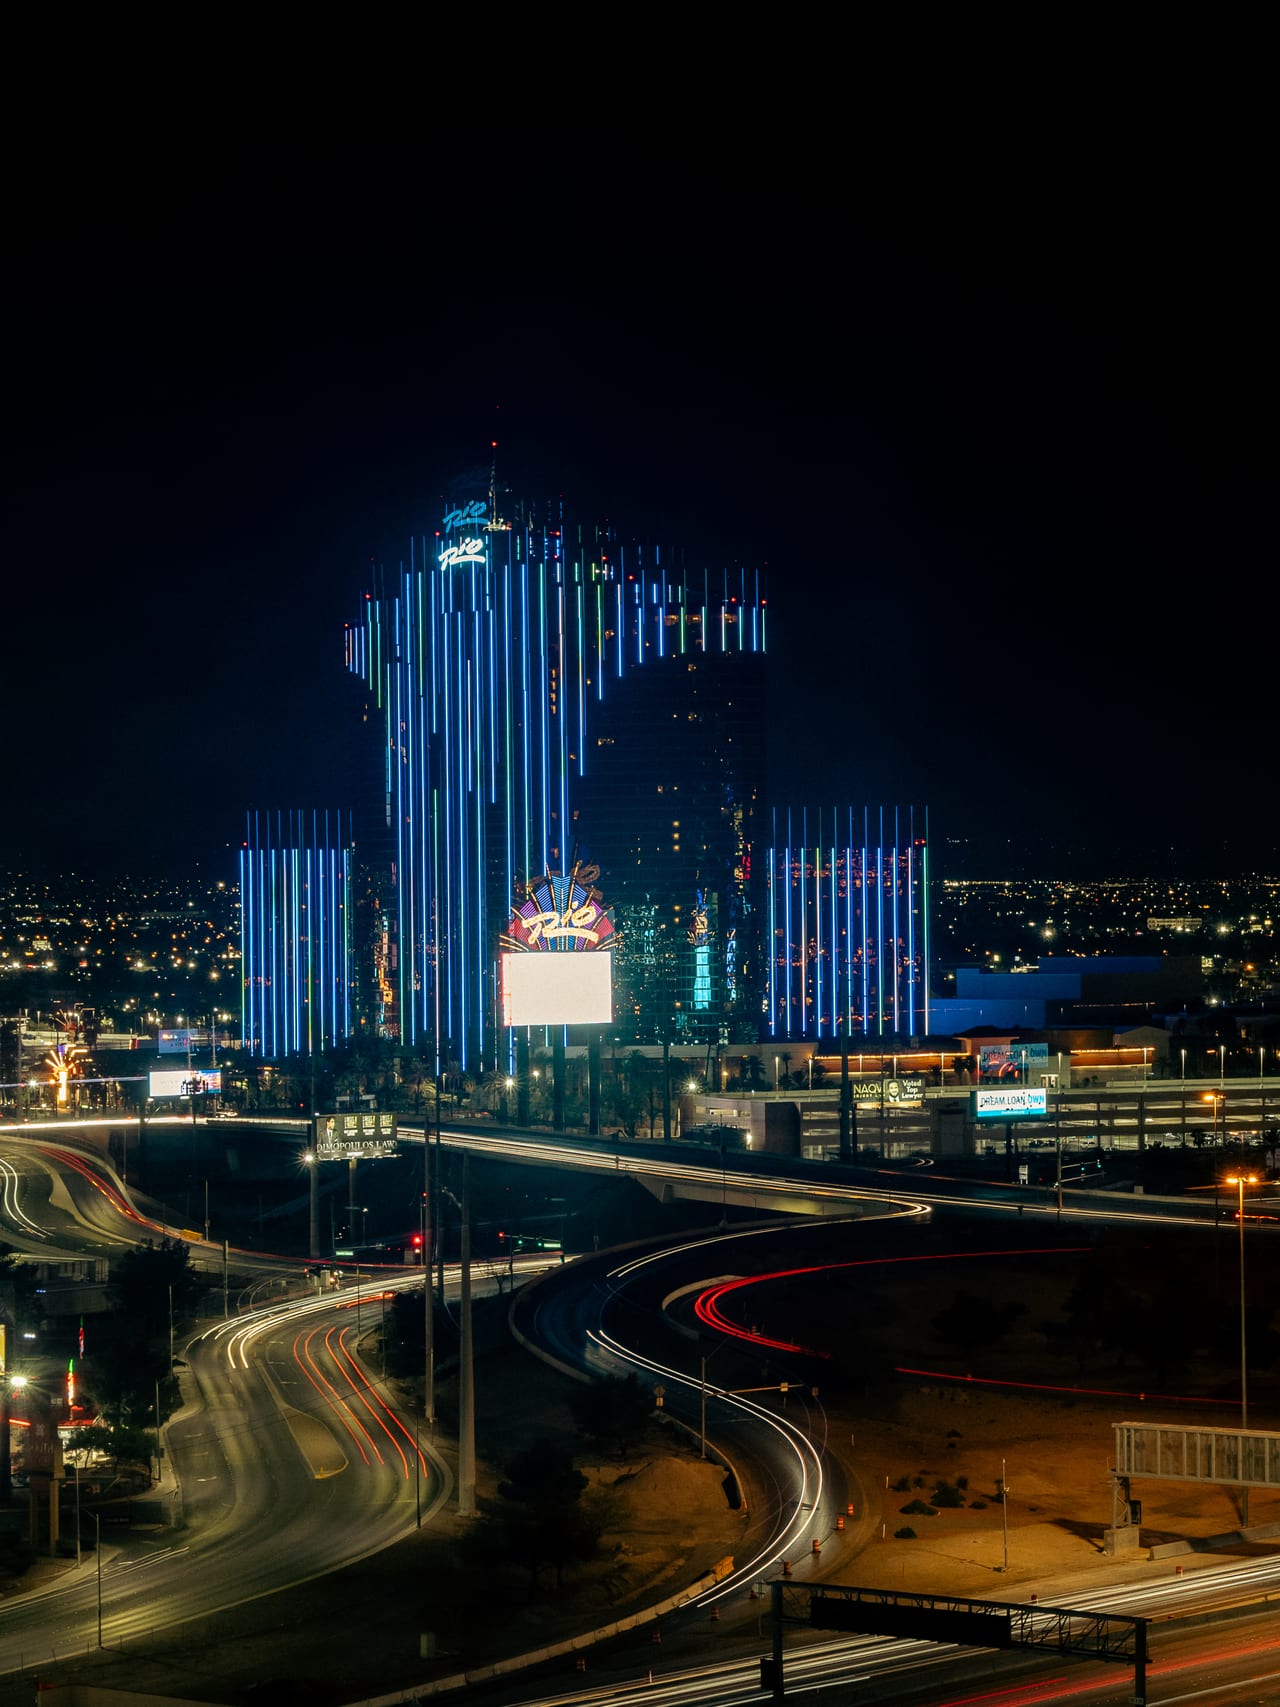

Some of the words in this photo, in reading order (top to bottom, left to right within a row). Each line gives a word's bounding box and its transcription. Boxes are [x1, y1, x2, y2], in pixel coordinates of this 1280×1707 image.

[438, 537, 486, 571] Rio
[522, 901, 599, 944] Rio
[376, 1140, 397, 1151] LAW
